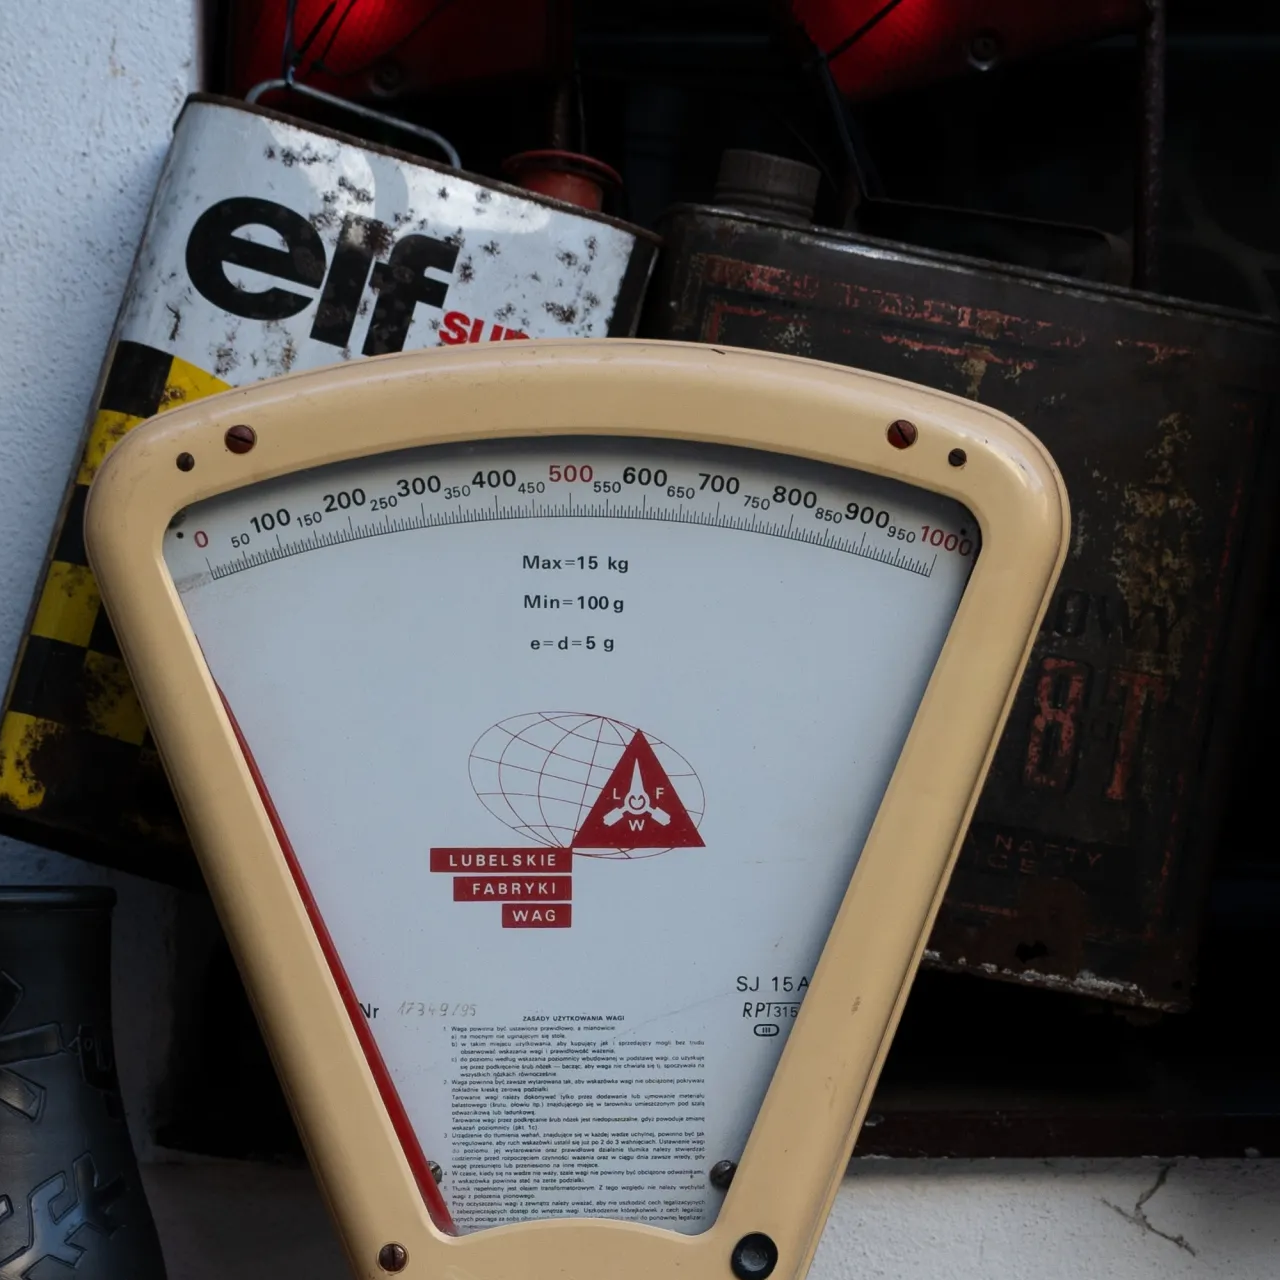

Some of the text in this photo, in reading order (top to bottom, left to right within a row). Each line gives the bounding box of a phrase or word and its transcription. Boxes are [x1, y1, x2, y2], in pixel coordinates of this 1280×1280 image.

[186, 196, 460, 356] elf
[193, 464, 971, 557] 0 50 100 150 200 250 300 350 400 450 500 550 600 650 700 750 800 850 900 950 1000
[608, 556, 628, 573] kg
[613, 599, 624, 613] g
[603, 638, 614, 652] g
[613, 788, 664, 800] L F
[629, 820, 645, 831] W
[449, 854, 557, 867] LUBELSKIE
[472, 882, 557, 895] FABRYKI
[512, 909, 557, 922] WAG
[736, 976, 759, 992] SJ
